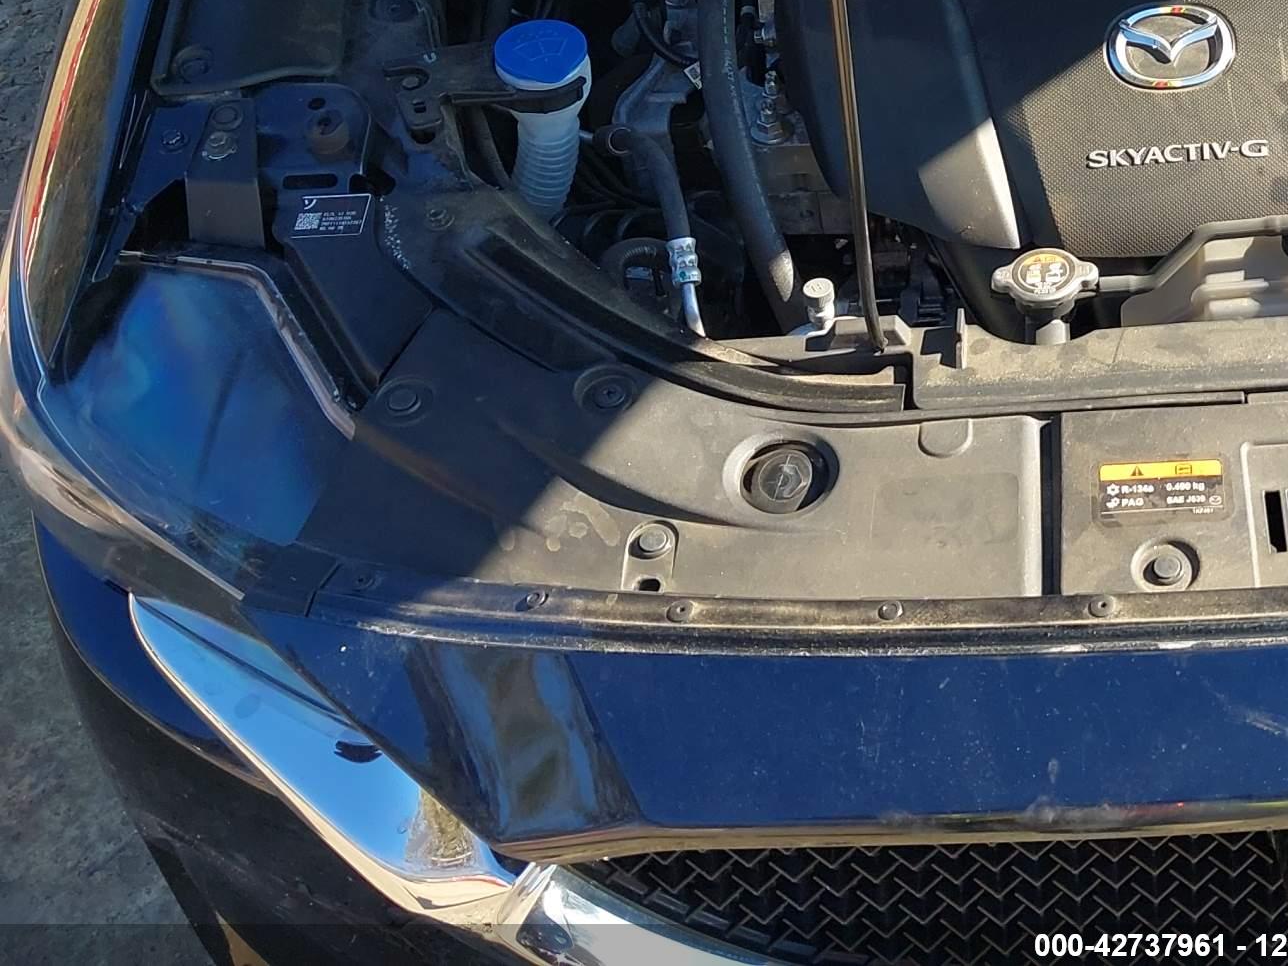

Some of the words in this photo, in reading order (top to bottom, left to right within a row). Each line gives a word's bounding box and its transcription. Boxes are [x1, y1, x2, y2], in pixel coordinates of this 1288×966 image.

[1086, 139, 1269, 169] SKYACTIV-G
[1121, 484, 1154, 494] R-134a
[1192, 481, 1205, 492] kg
[1121, 497, 1145, 508] PAG
